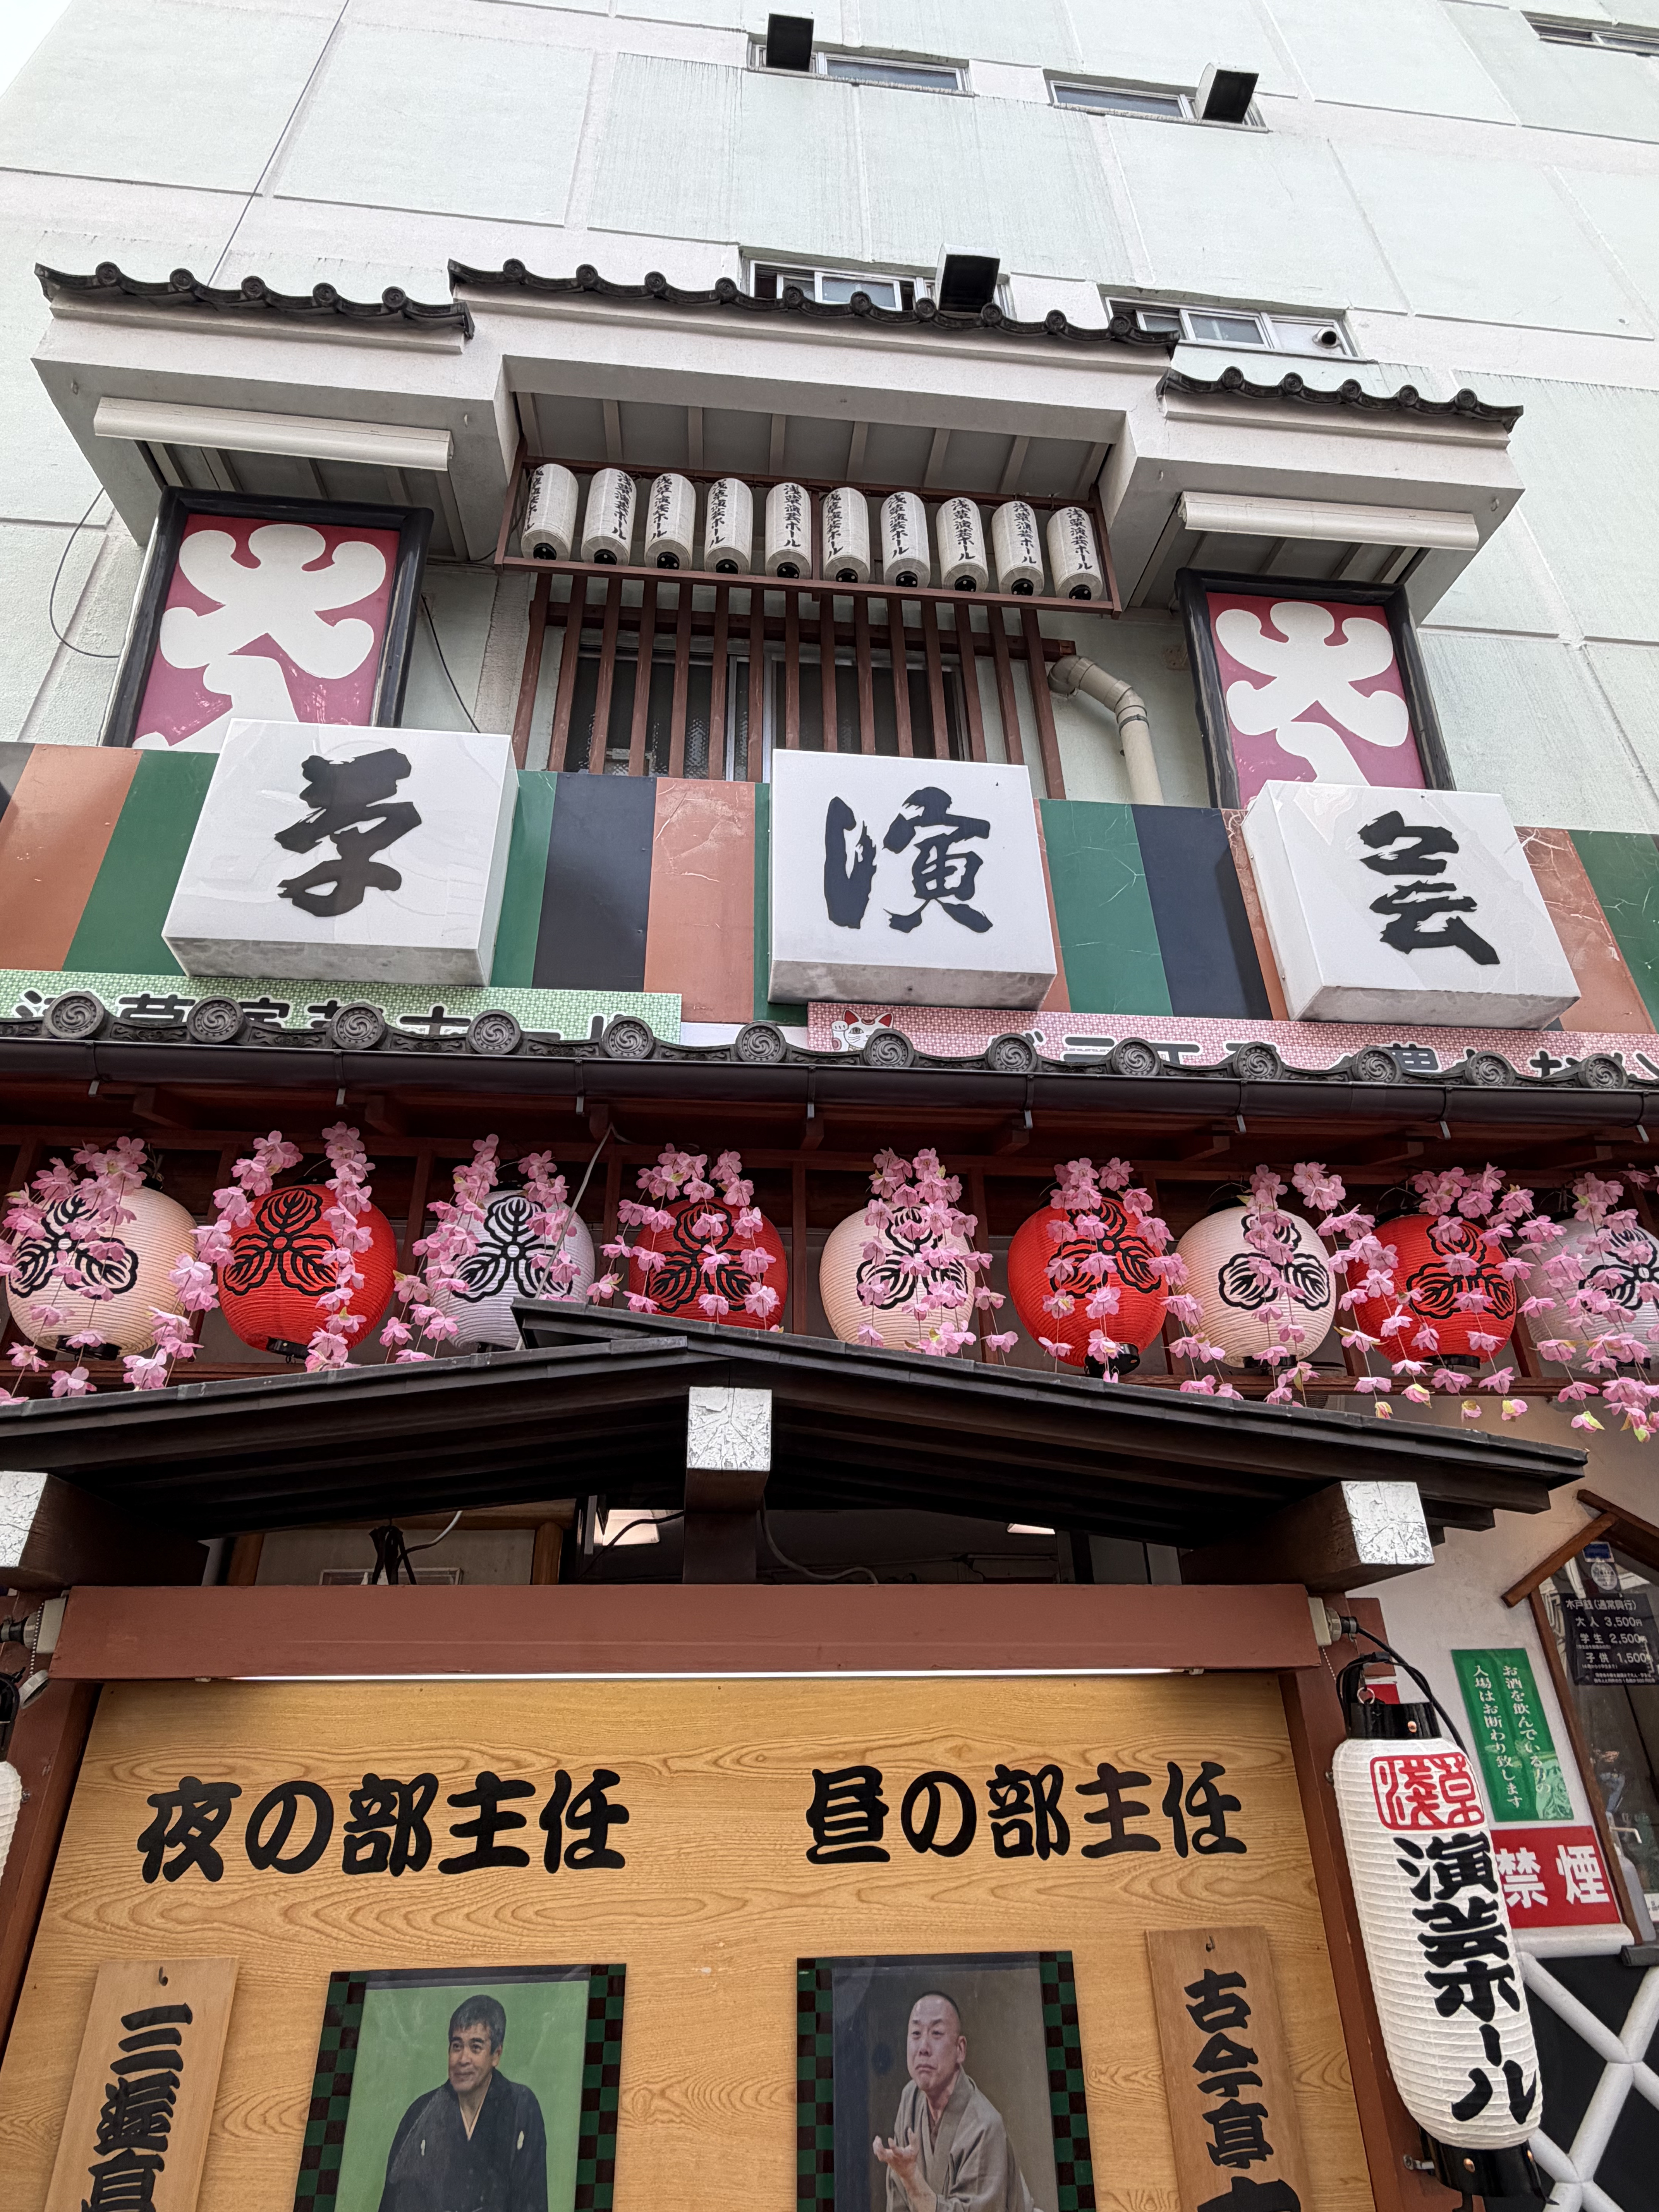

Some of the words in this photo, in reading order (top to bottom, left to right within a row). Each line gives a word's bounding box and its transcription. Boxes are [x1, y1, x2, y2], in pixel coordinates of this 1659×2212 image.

[1617, 1652, 1654, 1664] 1,500
[137, 1769, 629, 1883] 夜の部主任
[806, 1761, 1247, 1864] 昼の部主任
[1495, 1845, 1610, 1909] 禁煙
[1393, 1831, 1538, 2125] 演芸ホール
